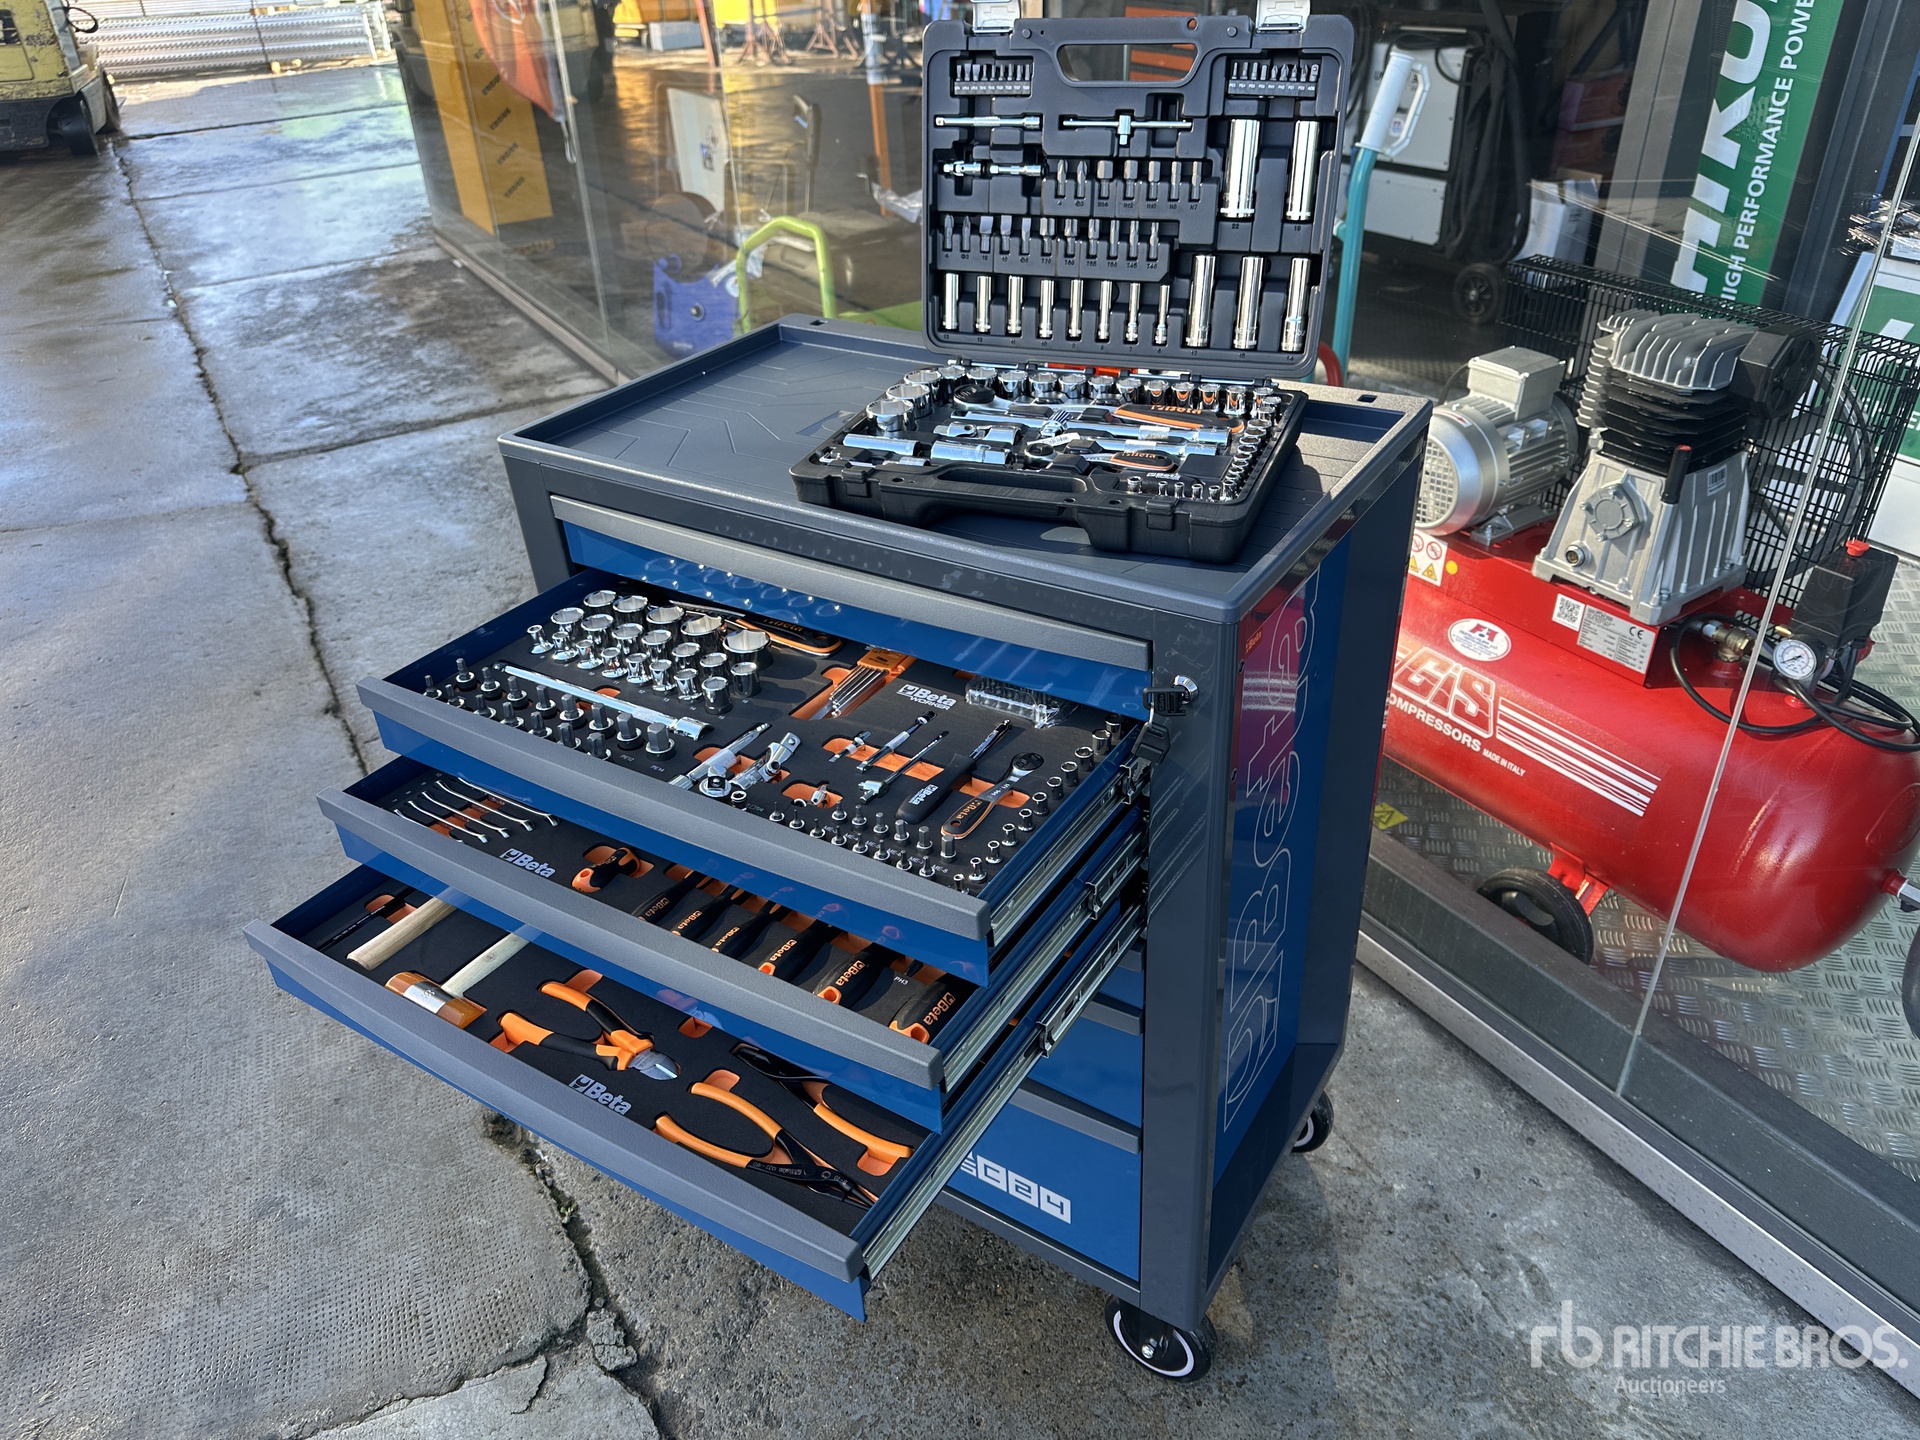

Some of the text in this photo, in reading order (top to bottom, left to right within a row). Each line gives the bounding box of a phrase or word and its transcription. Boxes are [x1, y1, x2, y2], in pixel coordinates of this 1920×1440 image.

[1670, 0, 1778, 293] HIKO
[1734, 77, 1794, 250] PERFORMANCE
[909, 696, 951, 711] WORKER
[914, 687, 957, 707] Beta
[1389, 692, 1482, 752] OMPRESSORS
[1482, 748, 1500, 764] MADE
[1506, 761, 1526, 777] ITALY
[956, 803, 978, 820] Beta
[514, 853, 556, 878] Beta
[677, 914, 698, 930] Beta
[769, 943, 792, 961] Beta
[835, 966, 859, 986] Beta
[893, 976, 908, 985] PH3
[923, 998, 950, 1025] Beta
[585, 1081, 632, 1116] Beta
